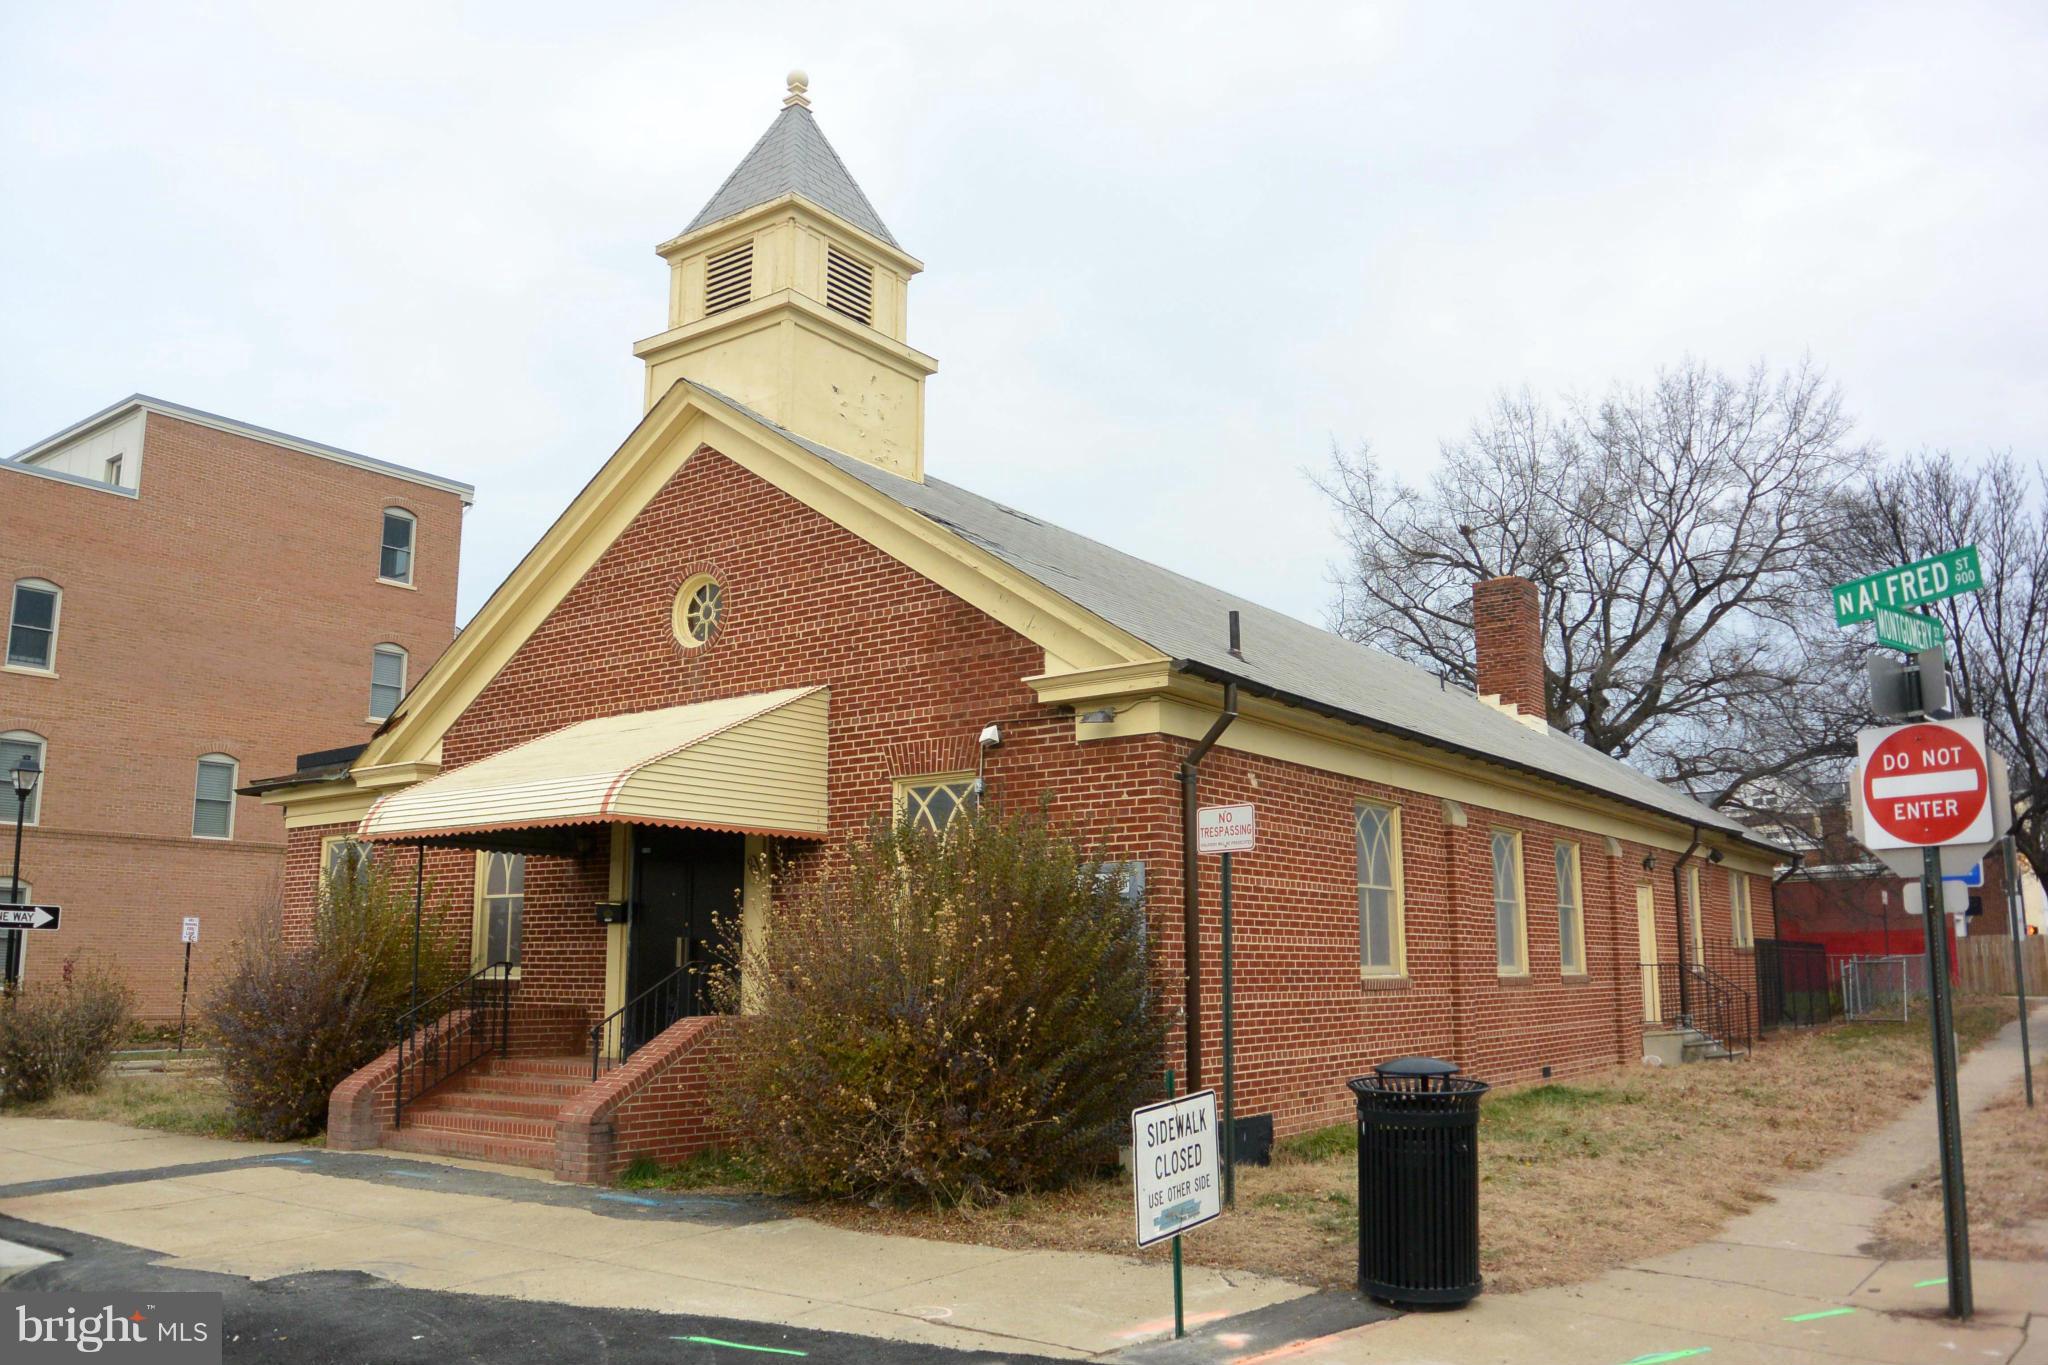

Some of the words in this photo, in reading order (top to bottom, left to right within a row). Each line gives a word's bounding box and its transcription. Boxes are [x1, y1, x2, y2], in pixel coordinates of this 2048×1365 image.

[1955, 556, 1969, 570] ST
[1954, 569, 1976, 585] 900
[1839, 593, 1854, 615] N
[1876, 607, 1933, 649] MONTGOMERY
[1883, 753, 1909, 771] DO
[1922, 747, 1962, 767] NOT
[1218, 812, 1233, 823] NO
[1894, 799, 1959, 821] ENTER
[1200, 823, 1252, 838] TRESPASSING
[13, 912, 35, 922] WAY
[1147, 1107, 1207, 1148] SIDEWALK
[1154, 1143, 1202, 1180] CLOSED
[1148, 1190, 1164, 1209] USE
[1167, 1183, 1191, 1202] OTHER
[1194, 1173, 1211, 1193] SIDE
